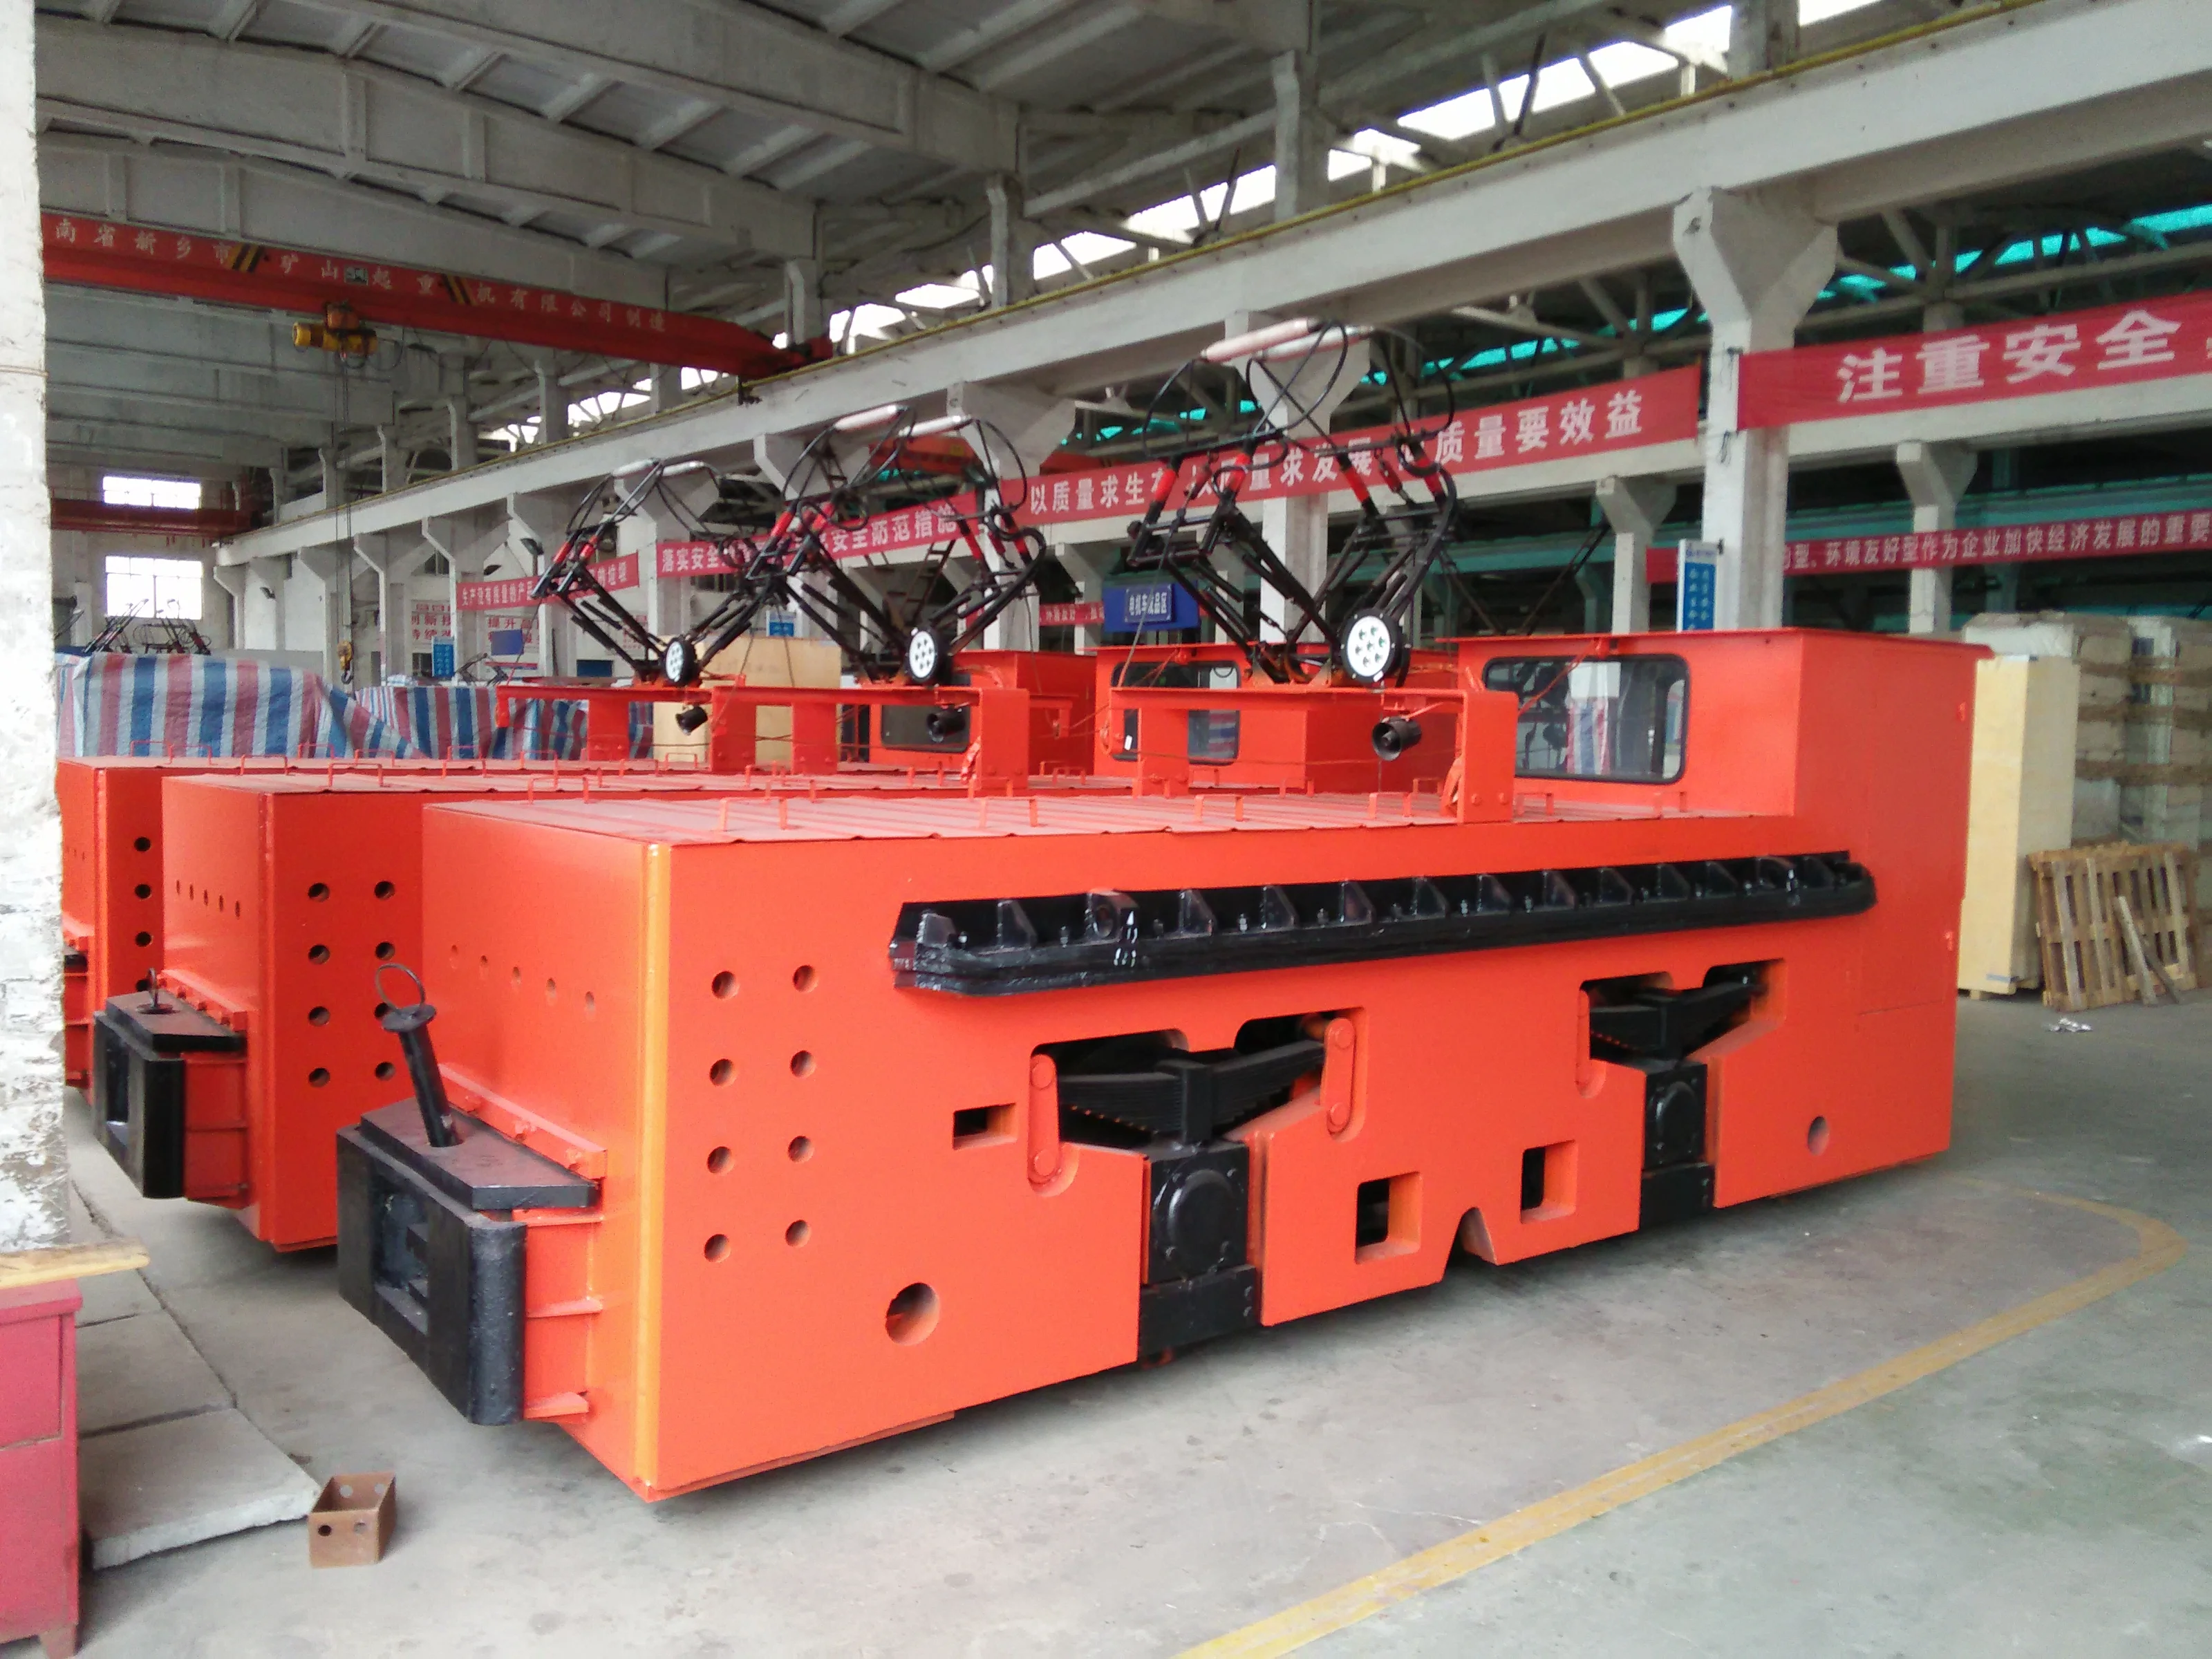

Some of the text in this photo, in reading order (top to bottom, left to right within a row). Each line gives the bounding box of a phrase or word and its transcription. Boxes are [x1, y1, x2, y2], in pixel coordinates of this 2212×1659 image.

[1836, 309, 2212, 403] 注重安全
[1398, 389, 1643, 470] 质量要效益
